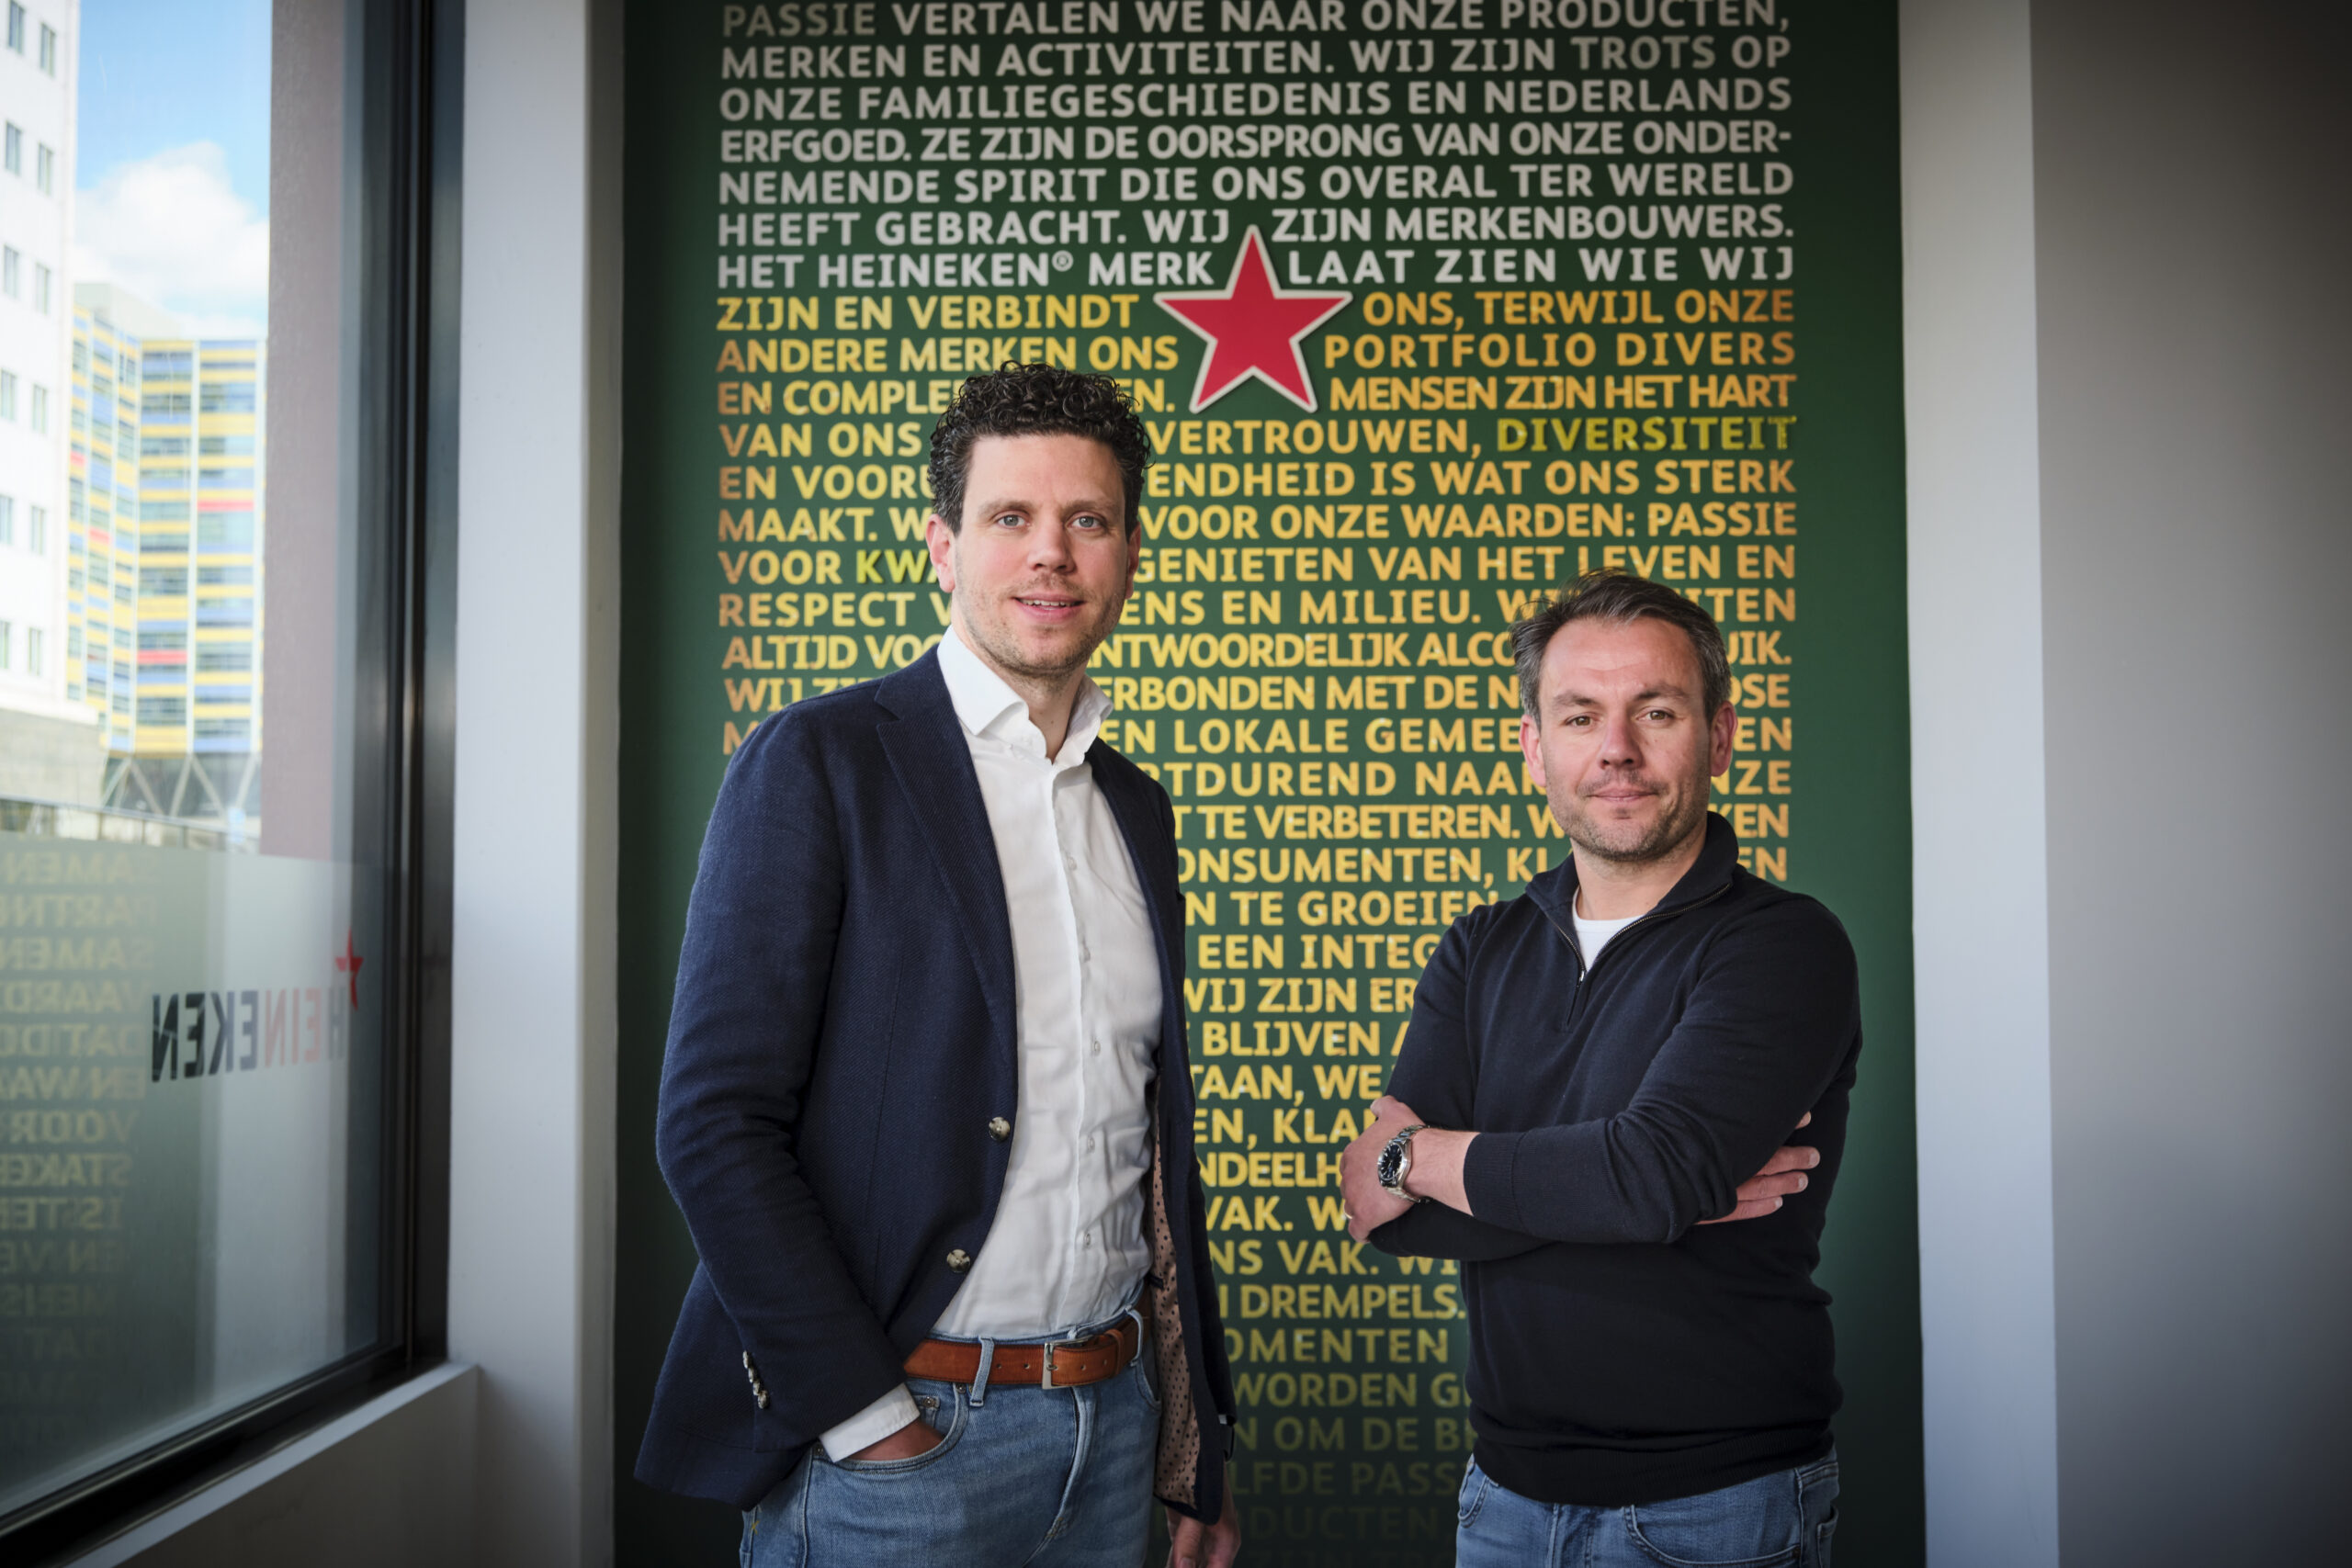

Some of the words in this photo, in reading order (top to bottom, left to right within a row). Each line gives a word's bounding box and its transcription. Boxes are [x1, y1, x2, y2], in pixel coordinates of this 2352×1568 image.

[724, 3, 875, 37] PASSIE
[893, 2, 1118, 35] VERTALEN
[1136, 0, 1204, 32] WE
[1222, 0, 1346, 31] NAAR
[1362, 0, 1484, 30] ONZE
[1501, 0, 1789, 33] PRODUCTEN,
[722, 45, 905, 78] MERKEN
[924, 44, 979, 76] EN
[996, 41, 1333, 76] ACTIVITEITEN.
[1350, 39, 1433, 73] WIJ
[1451, 39, 1554, 72] ZIJN
[1570, 36, 1715, 70] TROTS
[1732, 36, 1790, 68] OP
[720, 87, 842, 120] ONZE
[860, 82, 1390, 118] FAMILIEGESCHIEDENIS
[1408, 81, 1465, 114] EN
[1485, 78, 1791, 113] NEDERLANDS
[722, 129, 911, 162] ERFGOED.
[921, 128, 970, 161] ZE
[980, 127, 1073, 160] ZIJN
[1086, 126, 1138, 159] DE
[1148, 123, 1402, 159] OORSPRONG
[1413, 123, 1499, 156] VAN
[1510, 122, 1623, 155] ONZE
[1634, 120, 1791, 154] ONDER-
[720, 170, 939, 204] NEMENDE
[956, 168, 1106, 203] SPIRIT
[1121, 167, 1197, 201] DIE
[1213, 166, 1305, 200] ONS
[1320, 165, 1497, 199] OVERAL
[1510, 164, 1592, 197] TER
[1608, 163, 1792, 196] WERELD
[719, 212, 860, 246] HEEFT
[876, 210, 1125, 245] GEBRACHT.
[1143, 209, 1228, 243] WIJ
[1272, 209, 1371, 242] ZIJN
[1385, 205, 1792, 241] MERKENBOUWERS.
[718, 254, 804, 288] HET
[820, 251, 1073, 288] HEINEKEN®
[1089, 252, 1213, 286] MERK
[1289, 250, 1414, 284] LAAT
[1435, 249, 1555, 283] ZIEN
[1579, 248, 1677, 281] WIE
[1701, 247, 1792, 280] WIJ
[718, 297, 819, 331] ZIJN
[836, 296, 891, 330] EN
[908, 295, 1139, 329] VERBINDT
[1363, 292, 1464, 331] ONS,
[1475, 290, 1664, 324] TERWIJL
[1676, 289, 1793, 323] ONZE
[718, 338, 887, 372] ANDERE
[900, 337, 1077, 372] MERKEN
[1089, 336, 1178, 370] ONS
[1325, 333, 1596, 368] PORTFOLIO
[1617, 333, 1794, 366] DIVERS
[718, 381, 772, 414] EN
[784, 380, 966, 415] COMPLE
[1112, 378, 1175, 412] EN.
[1330, 377, 1497, 411] MENSEN
[1505, 376, 1596, 409] ZIJN
[1605, 375, 1682, 409] HET
[1690, 375, 1796, 408] HART
[720, 423, 811, 457] VAN
[829, 423, 922, 457] ONS
[1146, 419, 1480, 459] VERTROUWEN,
[1498, 417, 1796, 451] DIVERSITEIT
[720, 466, 775, 500] EN
[1148, 463, 1354, 497] ENDHEID
[1371, 461, 1415, 495] IS
[1430, 461, 1531, 495] WAT
[1545, 460, 1639, 494] ONS
[1656, 459, 1794, 494] STERK
[719, 507, 877, 542] MAAKT.
[1138, 505, 1259, 539] VOOR
[1272, 505, 1389, 539] ONZE
[1401, 503, 1634, 537] WAARDEN:
[1648, 502, 1796, 536] PASSIE
[719, 550, 842, 584] VOOR
[857, 549, 938, 584] KW
[1133, 547, 1352, 582] GENIETEN
[1368, 547, 1461, 581] VAN
[1478, 547, 1564, 581] HET
[1737, 545, 1794, 579] EN
[720, 592, 915, 626] RESPECT
[1119, 591, 1204, 625] ENS
[1223, 591, 1281, 625] EN
[1300, 590, 1480, 624] MILIEU.
[1674, 588, 1795, 622] TEN
[723, 636, 858, 670] ALTIJD
[1087, 633, 1410, 668] NTWOORDELIJK
[1418, 632, 1515, 666] ALCO
[1327, 676, 1416, 709] MET
[1424, 675, 1477, 709] DE
[1175, 719, 1348, 753] LOKALE
[1365, 717, 1522, 752] GEMEE
[1734, 716, 1792, 751] EN
[1196, 806, 1246, 839] TE
[1254, 805, 1520, 839] VERBETEREN.
[1230, 892, 1283, 925] TE
[1199, 935, 1283, 969] EEN
[1301, 934, 1441, 968] INTEG
[1258, 978, 1356, 1012] ZIJN
[1371, 977, 1418, 1012] ER
[1203, 1021, 1379, 1056] BLIJVEN
[1314, 1065, 1382, 1100] WE
[1193, 1109, 1257, 1150] EN,
[1198, 1152, 1342, 1187] NDEELH
[1210, 1240, 1263, 1275] NS
[1277, 1240, 1378, 1275] VAK.
[1241, 1283, 1466, 1319] DREMPELS.
[1225, 1328, 1448, 1362] OMENTEN
[1273, 1416, 1345, 1451] OM
[1363, 1416, 1419, 1451] DE
[1230, 1461, 1335, 1495] LFDE
[1352, 1461, 1461, 1495] PASS
